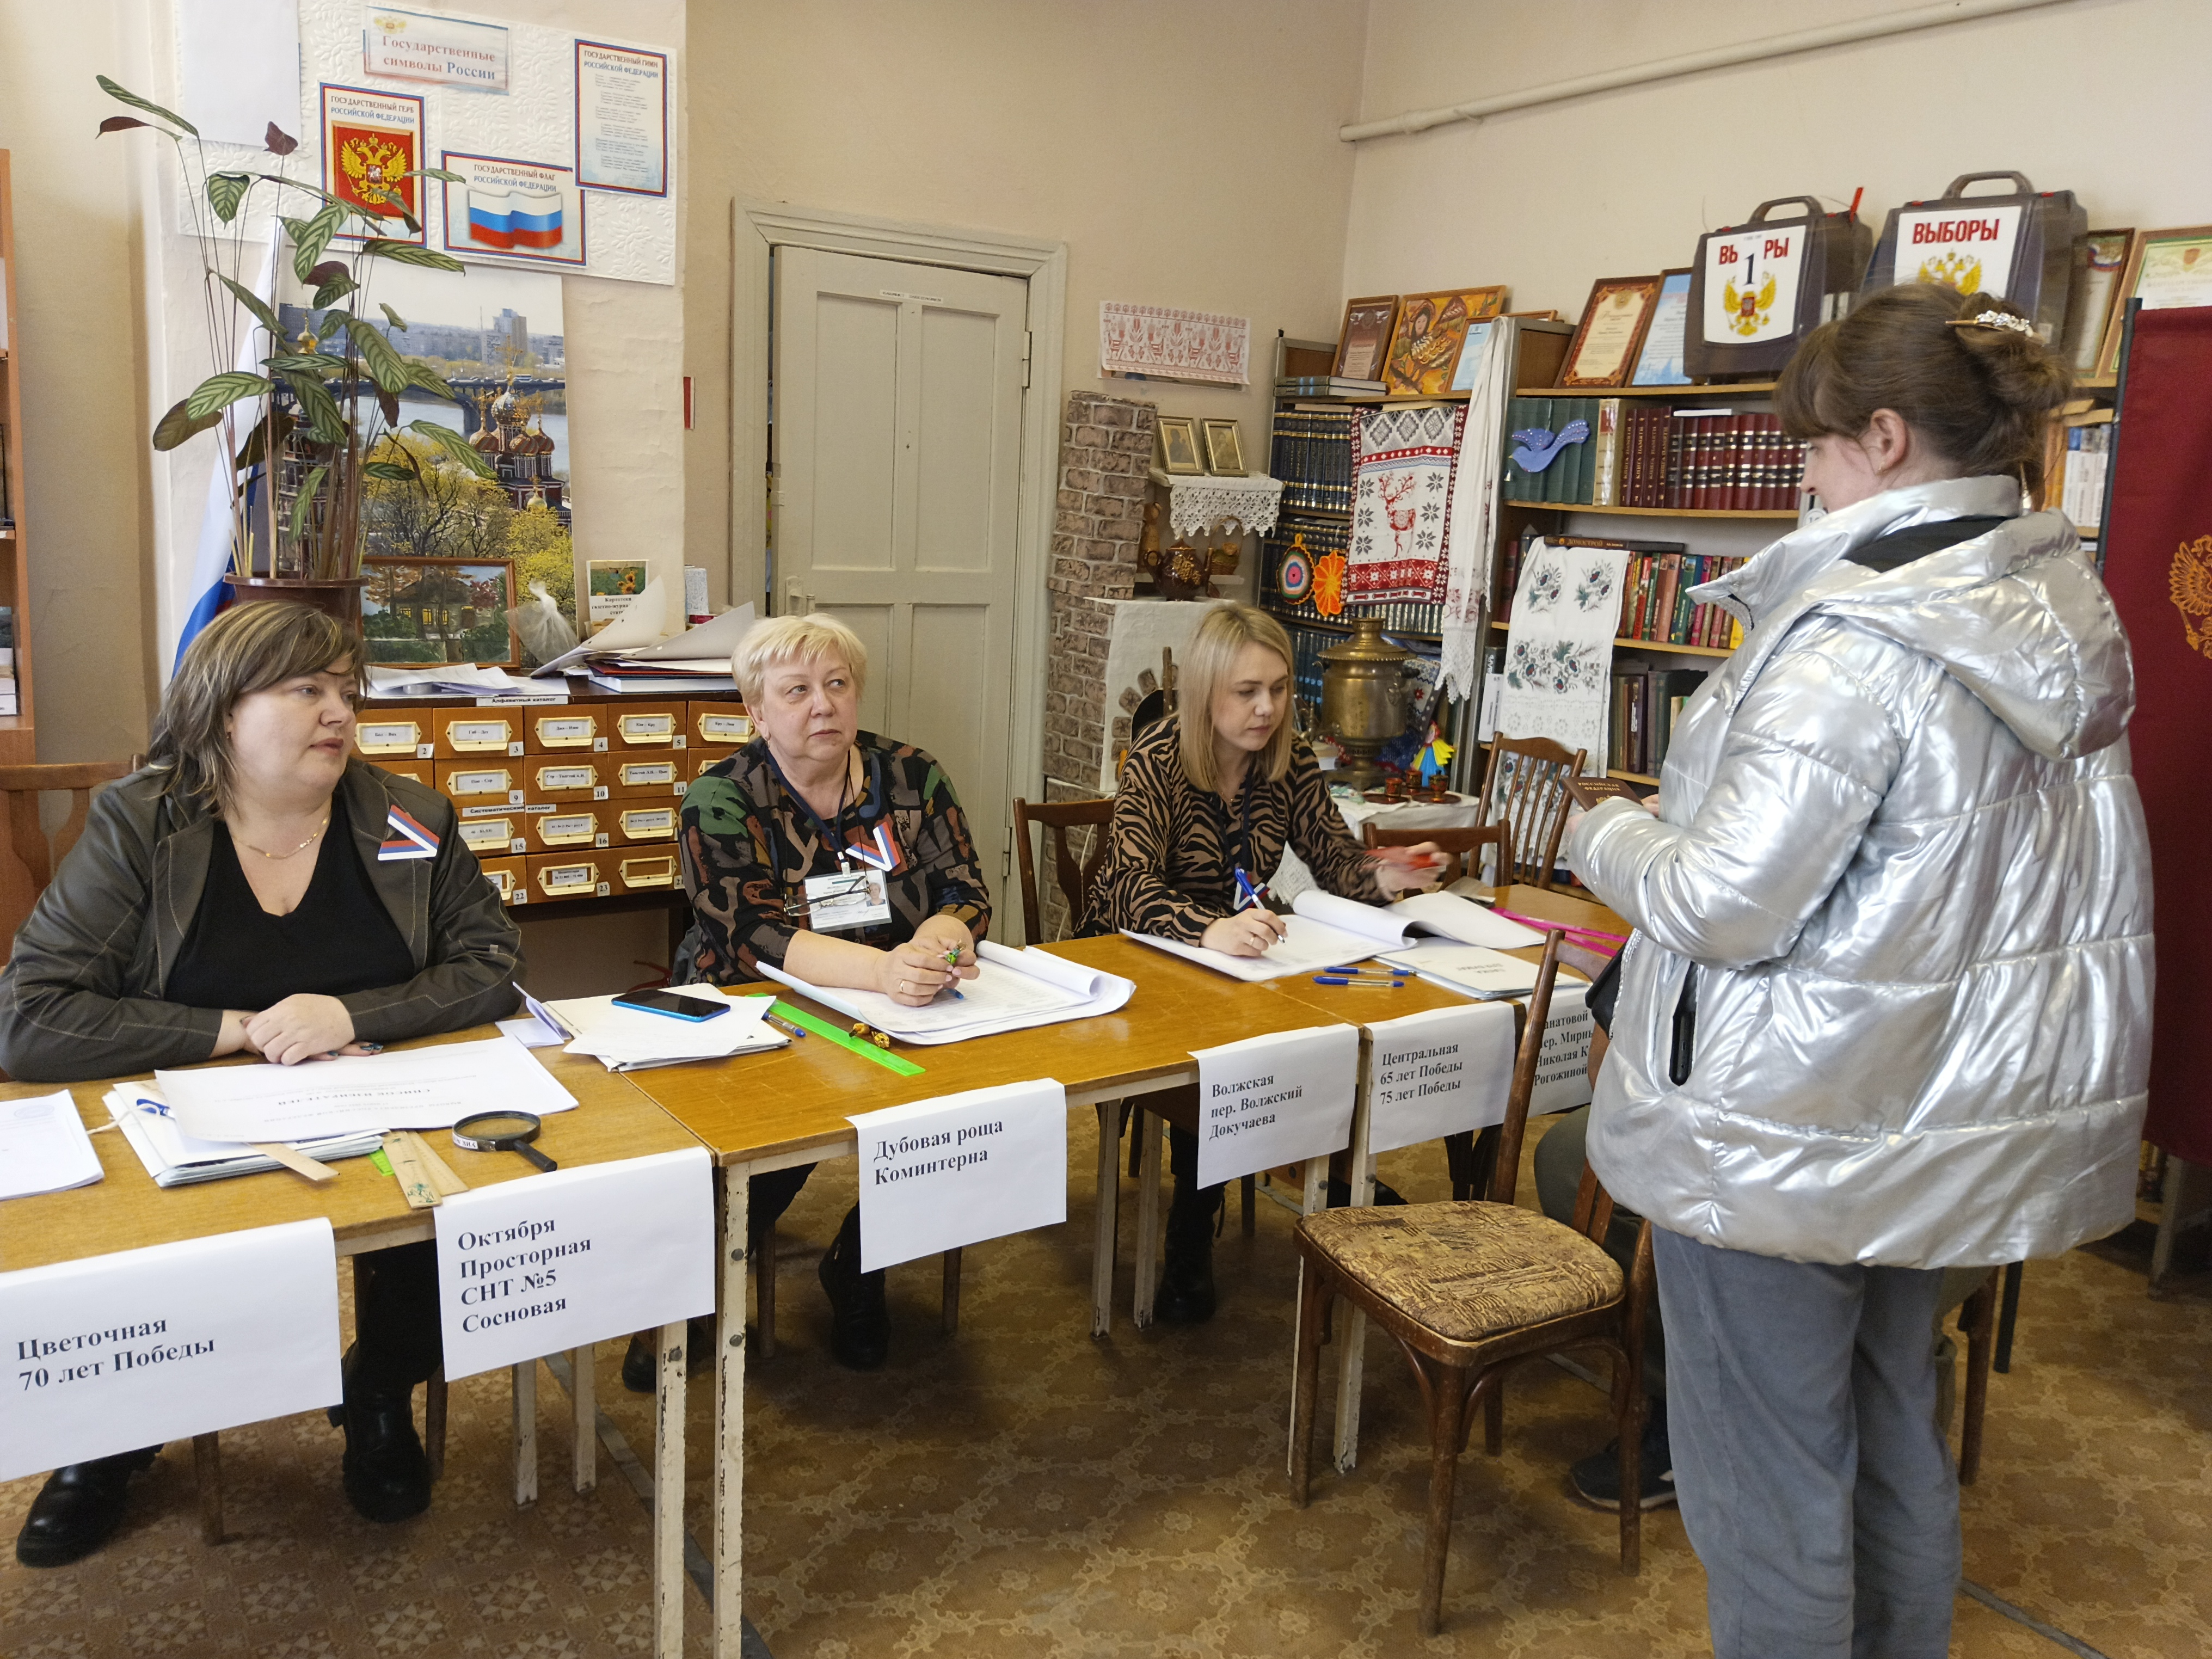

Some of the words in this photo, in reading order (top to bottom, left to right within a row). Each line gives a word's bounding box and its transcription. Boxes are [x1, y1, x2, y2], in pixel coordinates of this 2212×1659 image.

[383, 35, 496, 62] Государственные
[585, 50, 641, 65] ГОСУДАРСТВЕННЫЙ
[642, 60, 658, 68] ГИМН
[384, 56, 443, 72] символы
[447, 62, 495, 80] России
[584, 61, 623, 72] РОССИЙСКОЙ
[624, 67, 659, 78] ФЕДЕРАЦИИ
[331, 96, 397, 112] ГОСУДАРСТВЕННЫЙ
[398, 105, 414, 113] ГЕРБ
[331, 107, 374, 119] РОССИЙСКОЙ
[376, 113, 415, 124] ФЕДЕРАЦИИ
[474, 164, 538, 179] ГОСУДАРСТВЕННЫЙ
[539, 173, 556, 181] ФЛАГ
[474, 175, 517, 187] РОССИЙСКОЙ
[519, 181, 556, 192] ФЕДЕРАЦИИ
[1912, 219, 2000, 244] ВЫБОРЫ
[1743, 253, 1755, 286] 1
[1382, 1044, 1459, 1066] Центральная
[1380, 1071, 1393, 1085] 65
[1396, 1069, 1416, 1083] лет
[1420, 1061, 1463, 1078] Победы
[1534, 1064, 1587, 1086] Рогожиной
[1212, 1075, 1274, 1098] Волжская
[1380, 1092, 1393, 1105] 75
[1395, 1089, 1415, 1102] лет
[1418, 1080, 1461, 1096] Победы
[1211, 1105, 1236, 1118] пер.
[1240, 1085, 1303, 1111] Волжский
[1208, 1114, 1276, 1141] Докучаева
[874, 1130, 951, 1163] Дубовая
[957, 1120, 1003, 1146] роща
[875, 1150, 988, 1185] Коминтерна
[458, 1220, 556, 1251] Октября
[460, 1239, 592, 1280] Просторная
[461, 1278, 514, 1305] СНТ
[521, 1269, 556, 1293] №5
[463, 1298, 567, 1333] Сосновая
[17, 1319, 168, 1361] Цветочная
[19, 1368, 50, 1392] 70
[58, 1362, 104, 1384] лет
[114, 1339, 215, 1373] Победы
